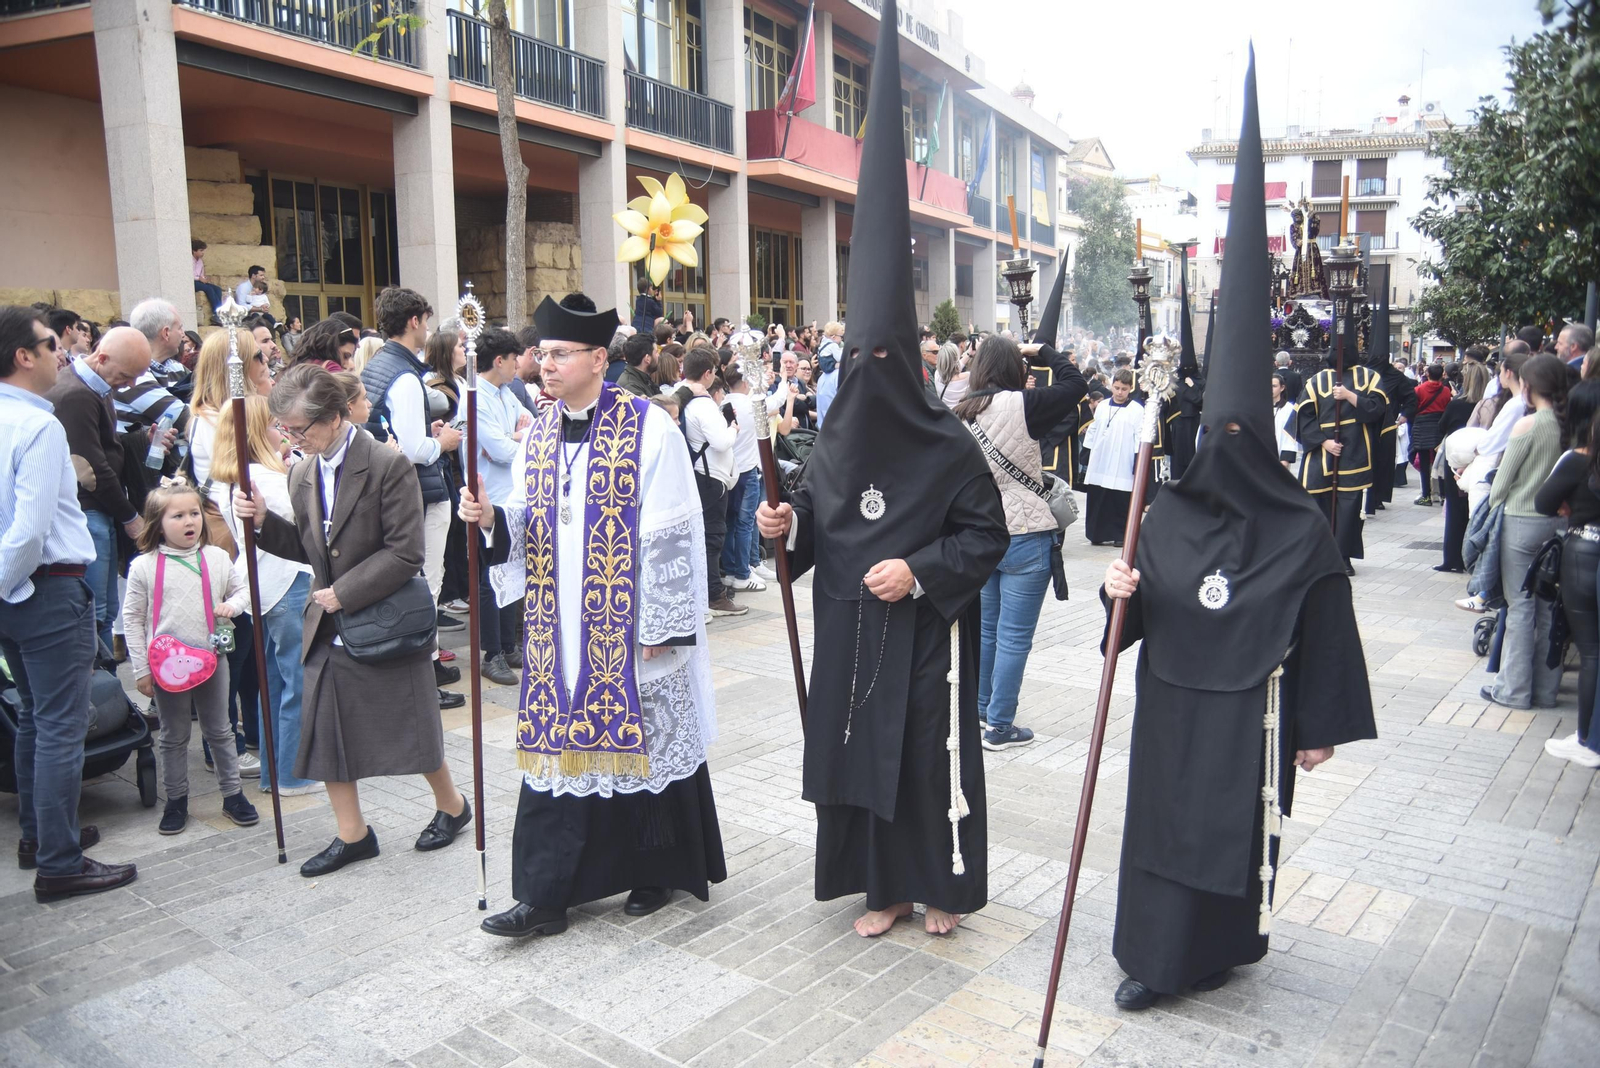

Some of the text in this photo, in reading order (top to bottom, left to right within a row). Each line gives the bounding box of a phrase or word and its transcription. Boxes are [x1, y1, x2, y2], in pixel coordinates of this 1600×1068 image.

[906, 12, 913, 34] DE
[991, 448, 1021, 478] GETTING
[1020, 475, 1044, 497] LIFE'S
[658, 556, 691, 584] JHS
[154, 637, 175, 650] PEPPA
[161, 642, 173, 651] PIG
